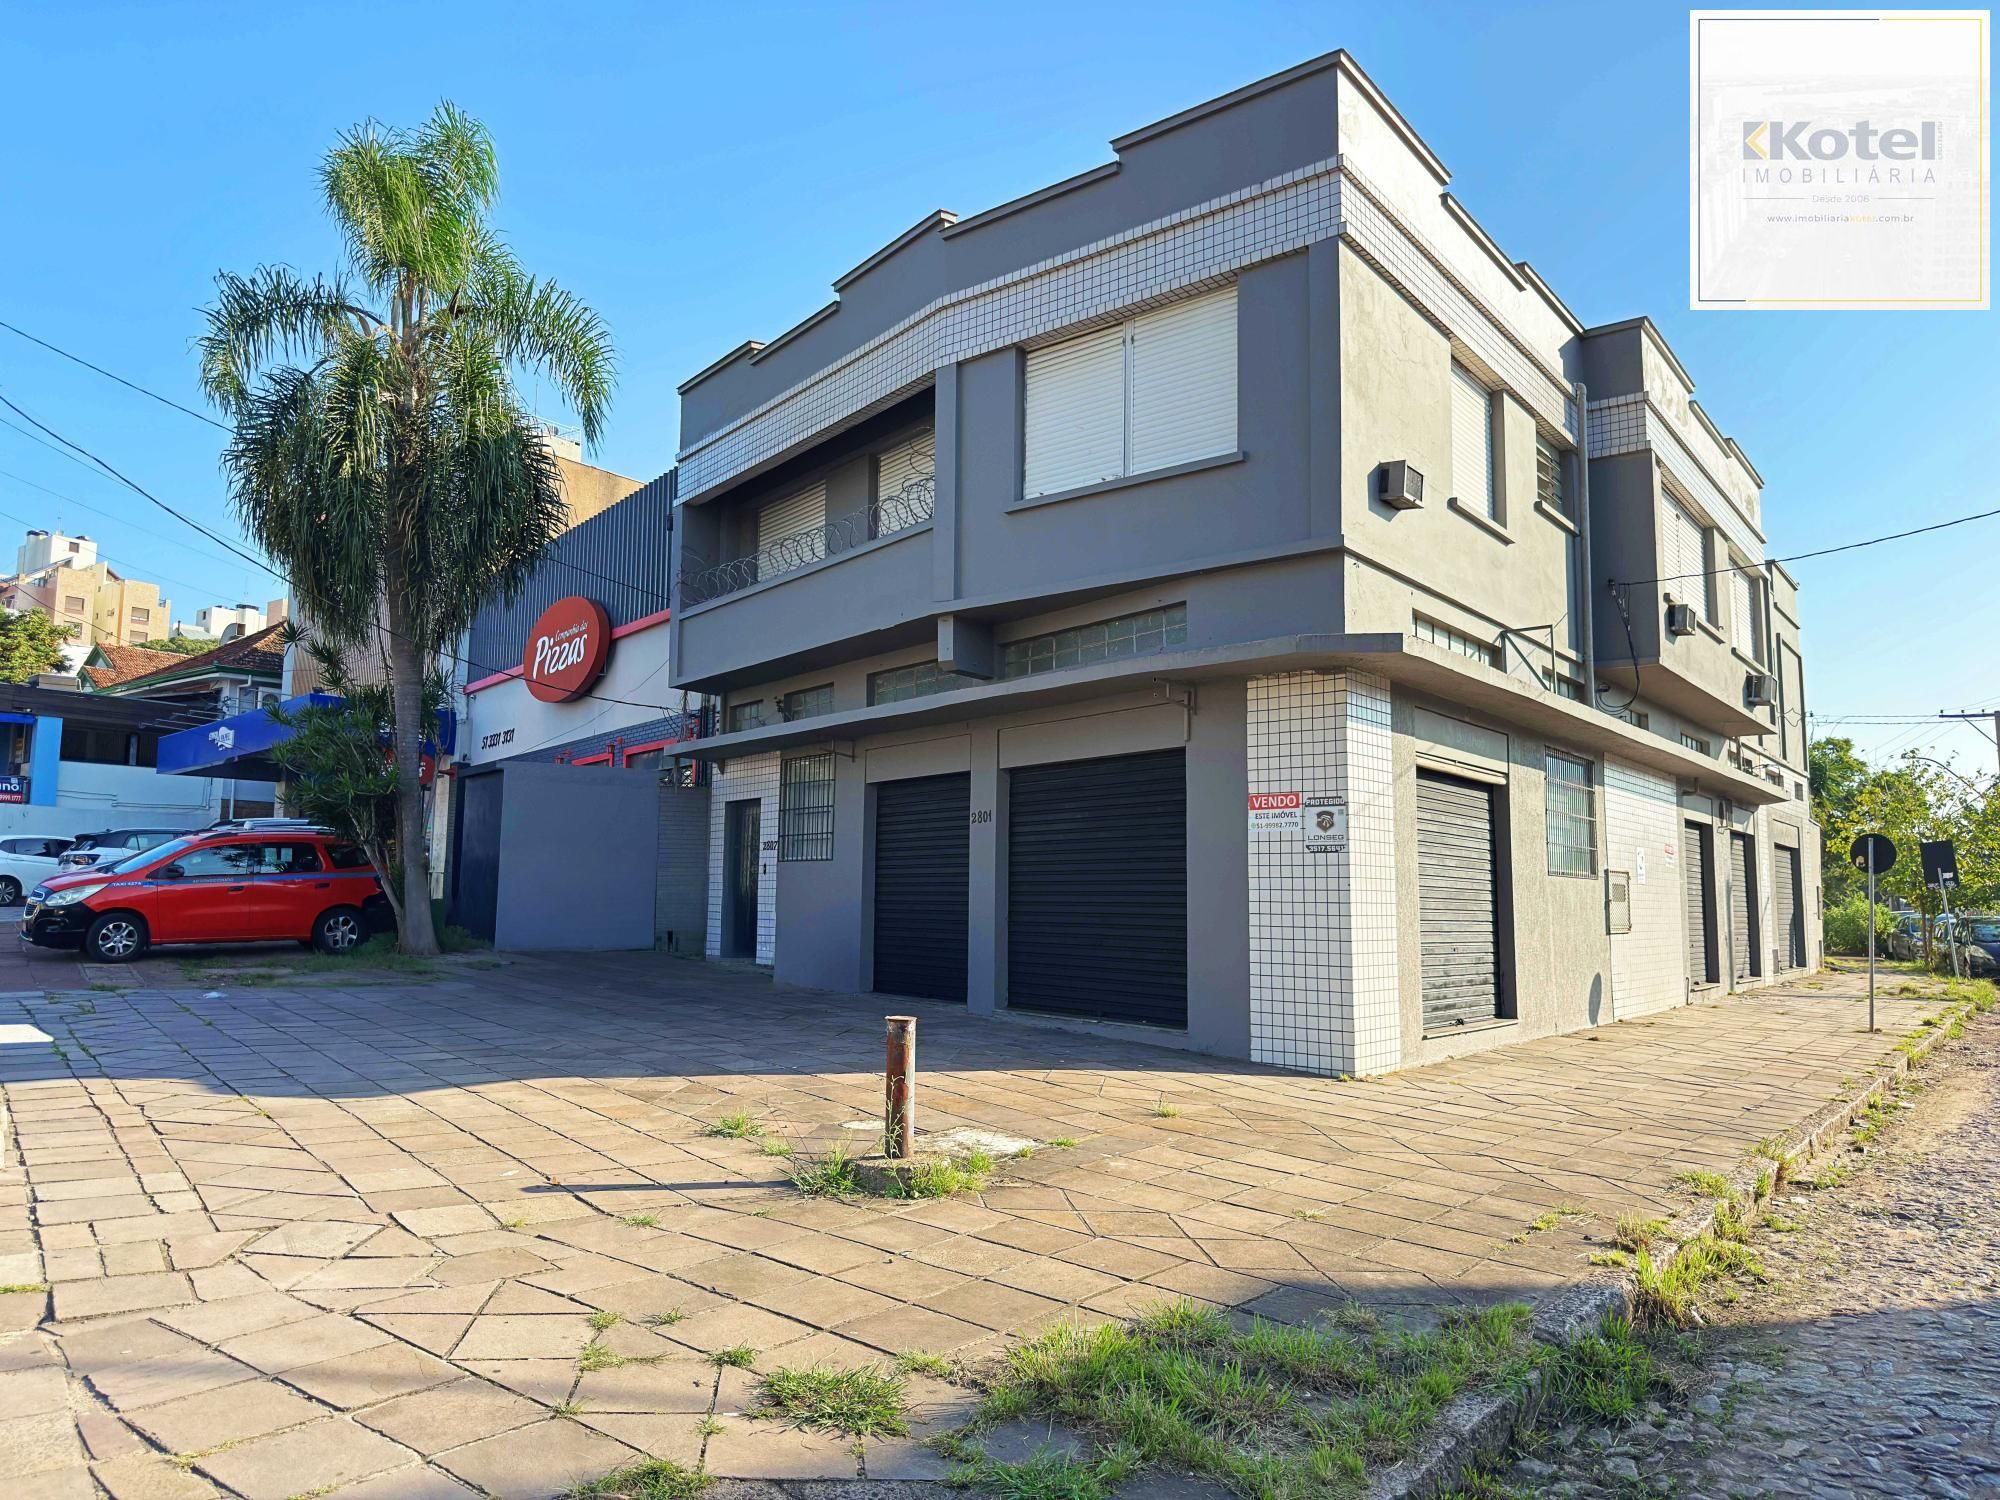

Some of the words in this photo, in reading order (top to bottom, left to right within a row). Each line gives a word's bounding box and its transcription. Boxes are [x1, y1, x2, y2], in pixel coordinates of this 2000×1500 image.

[532, 633, 588, 680] Pizzas
[1252, 795, 1297, 808] VENDO
[1305, 798, 1345, 806] PROTEGIDO
[971, 809, 992, 824] 2801
[1271, 810, 1298, 819] IMÓVEL
